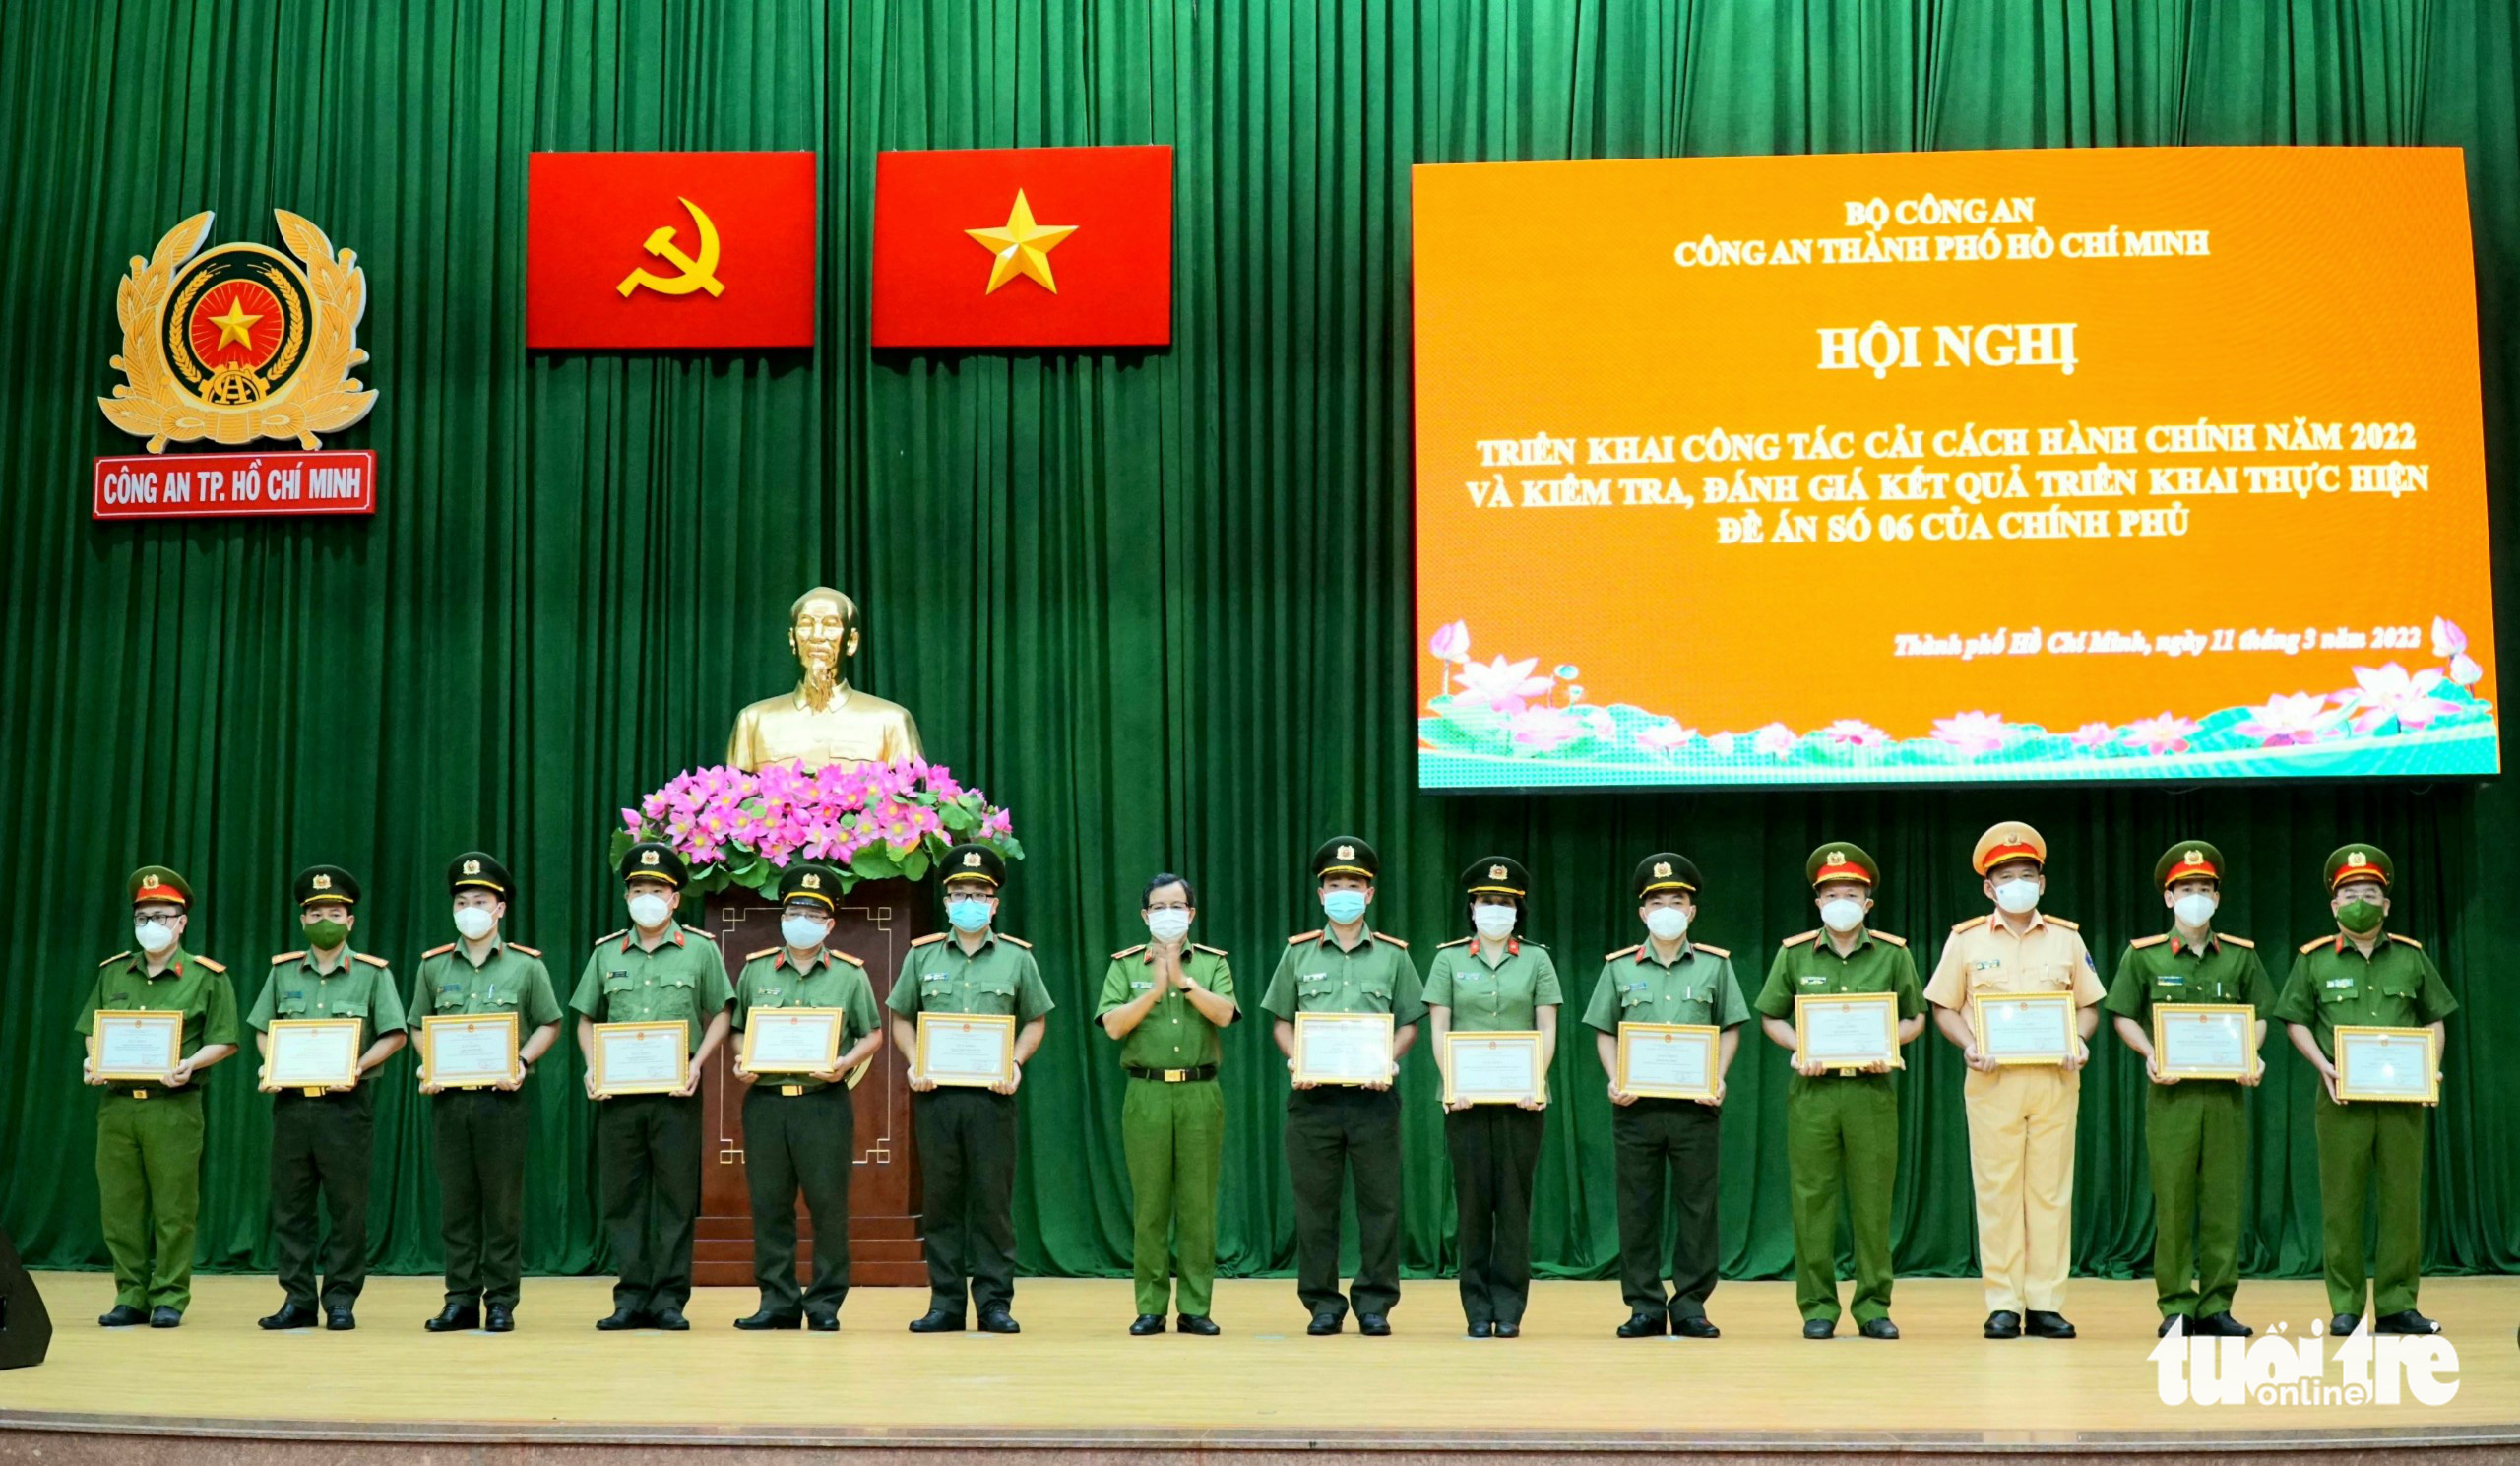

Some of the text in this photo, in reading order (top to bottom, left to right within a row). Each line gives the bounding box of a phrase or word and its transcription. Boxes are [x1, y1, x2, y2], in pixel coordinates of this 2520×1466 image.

[1846, 194, 2034, 231] BỘ CÔNG AN
[1674, 235, 1766, 266] CÔNG
[1769, 240, 1812, 264] AN
[1818, 232, 1929, 263] THÀNH
[2007, 227, 2054, 259] HỒ
[2061, 226, 2118, 257] CHÍ
[2124, 231, 2210, 256] MINH
[1817, 321, 2078, 378] HỘI NGHỊ
[1588, 435, 1674, 464] KHAI
[1682, 428, 1780, 462] CÔNG
[1788, 426, 1854, 460] TÁC
[1865, 425, 1923, 458] CẢI
[1933, 423, 2029, 457] CÁCH
[2039, 420, 2137, 455] HÀNH
[2146, 418, 2256, 453] CHÍNH
[2266, 418, 2342, 451] NĂM
[2351, 423, 2416, 450] 2022
[104, 459, 360, 503] CÔNG AN TP. HỒ CHÍ MINH
[1465, 474, 1513, 507] VÀ
[1618, 478, 1694, 509] TRA,
[1704, 470, 1799, 503] ĐÁNH
[1809, 467, 1868, 501] GIÁ
[1879, 466, 1949, 500] KẾT
[1956, 465, 2029, 504] QUẢ
[2150, 468, 2237, 494] KHAI
[2244, 462, 2339, 498] THỰC
[2350, 462, 2428, 497] HIỆN
[1772, 509, 1817, 542] ÁN
[1879, 515, 1913, 541] 06
[1922, 506, 1992, 540] CỦA
[1998, 504, 2110, 539] CHÍNH
[2119, 502, 2189, 537] PHỦ
[1895, 633, 1962, 656] Thành
[2047, 630, 2088, 654] Chí
[2088, 630, 2153, 657] Minh,
[2155, 630, 2208, 657] ngày
[2210, 629, 2235, 651] 11
[2239, 628, 2301, 655] tháng
[2302, 628, 2317, 650] 3
[2320, 627, 2366, 649] năm
[2370, 627, 2422, 649] 2022
